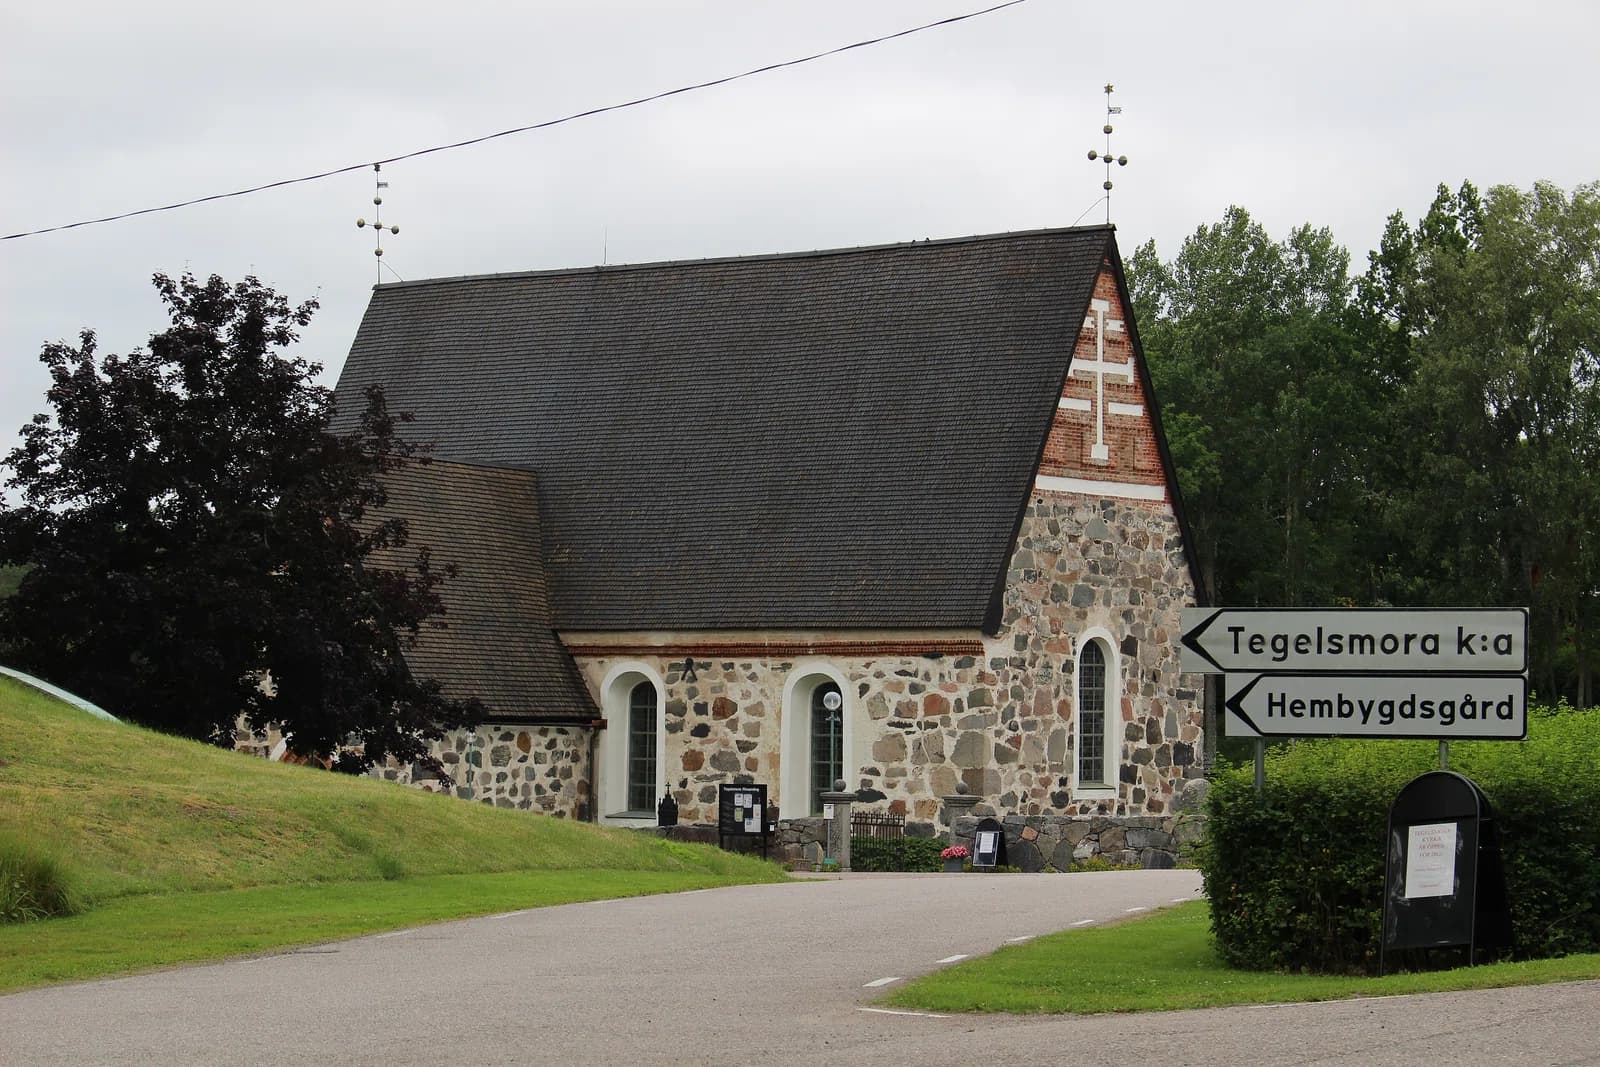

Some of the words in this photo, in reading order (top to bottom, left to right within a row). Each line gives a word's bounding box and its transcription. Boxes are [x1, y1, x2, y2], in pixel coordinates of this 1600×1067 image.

[1227, 625, 1440, 663] Tegelsmora
[1456, 625, 1513, 656] k:a
[1267, 692, 1514, 727] Hembygdsgård
